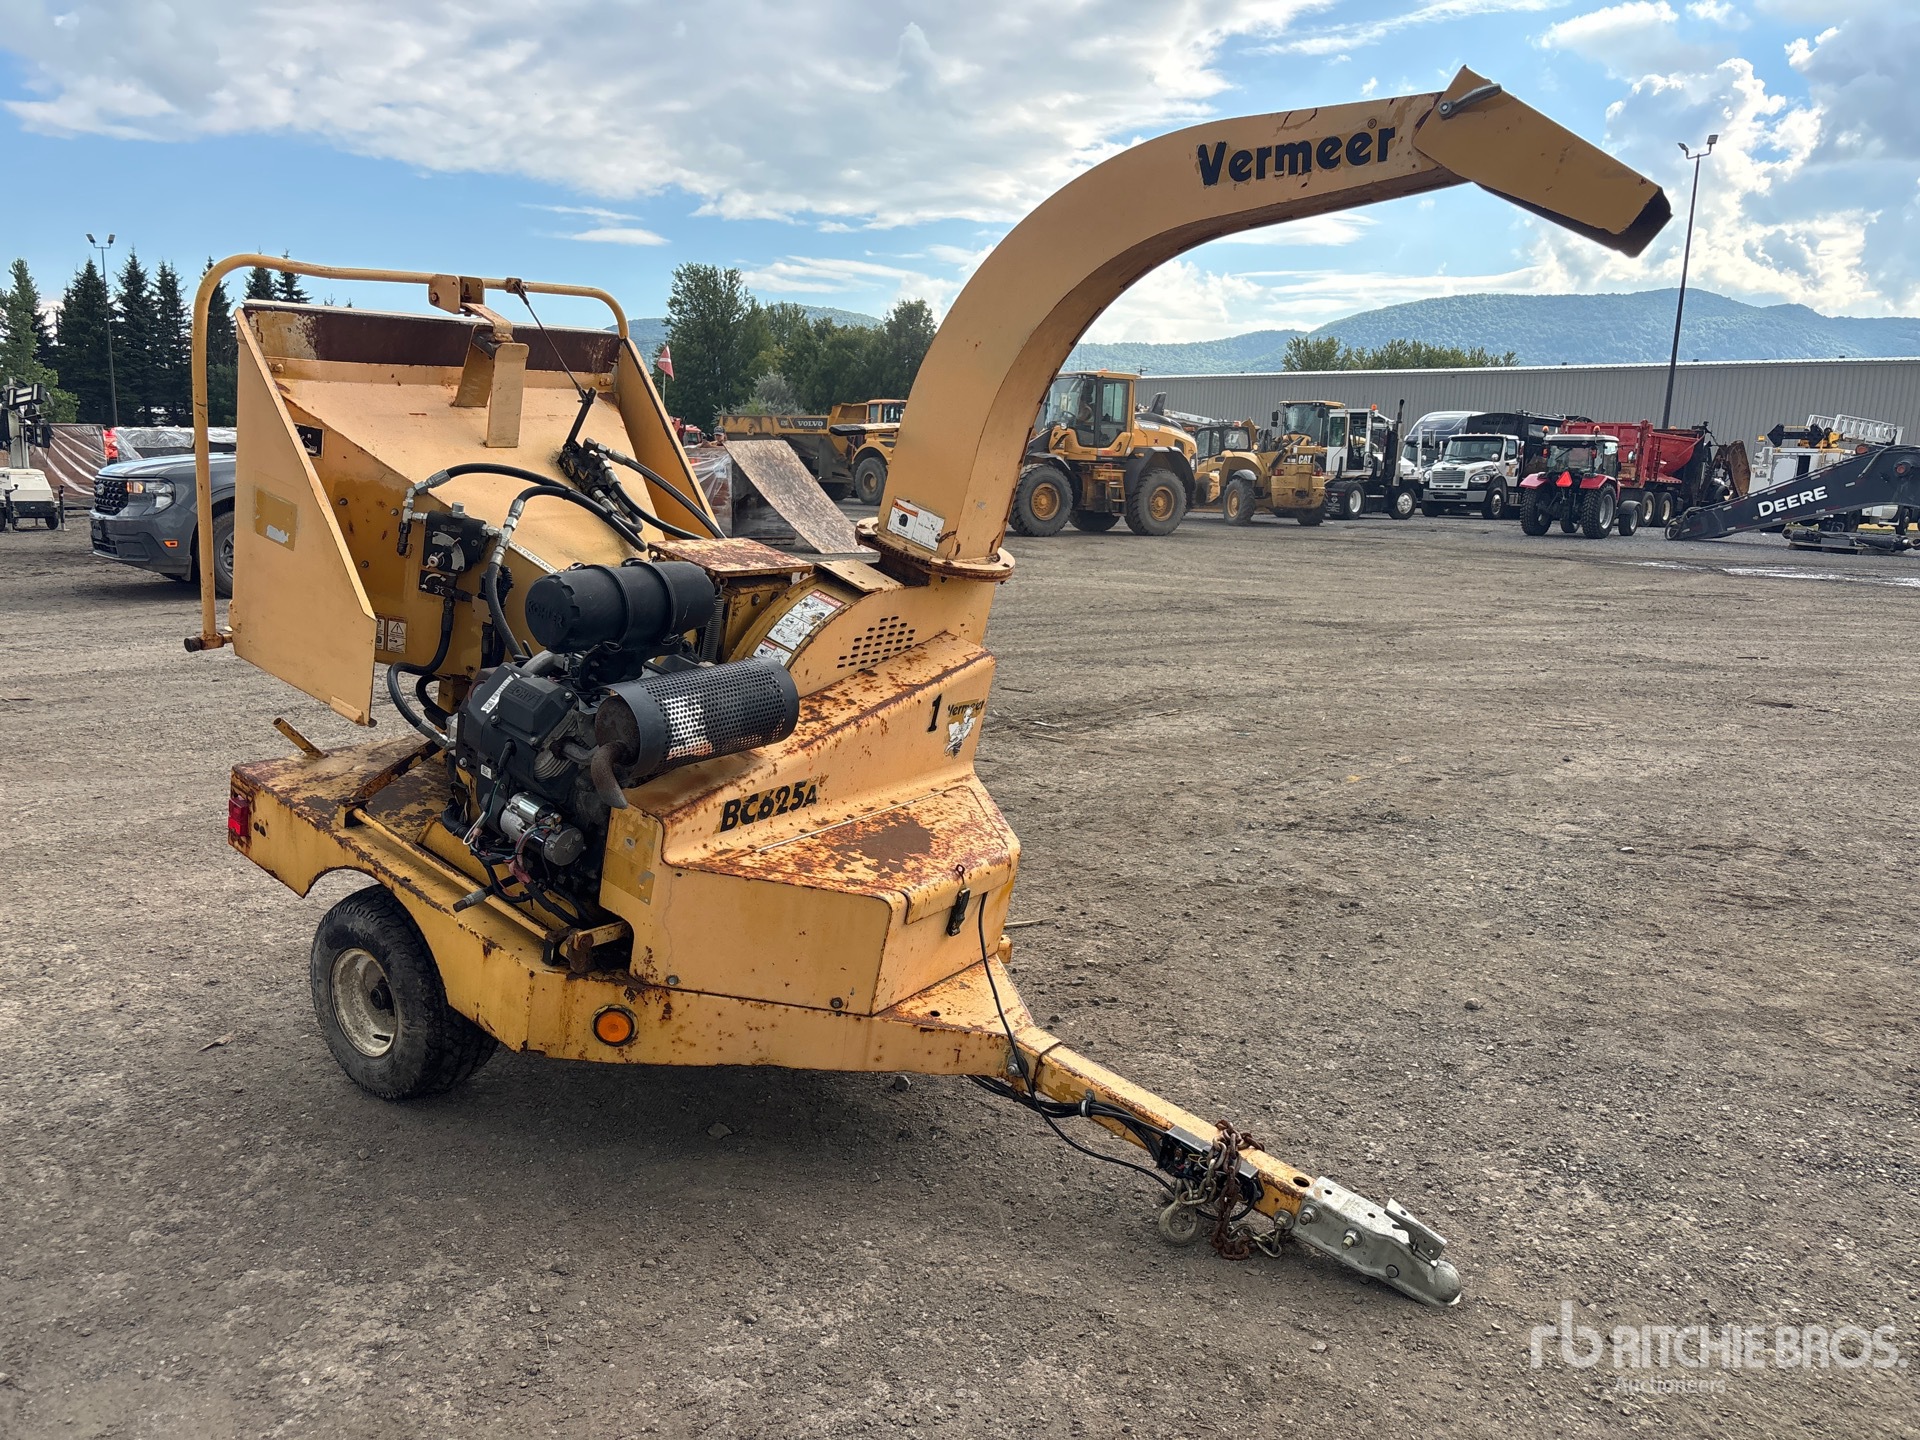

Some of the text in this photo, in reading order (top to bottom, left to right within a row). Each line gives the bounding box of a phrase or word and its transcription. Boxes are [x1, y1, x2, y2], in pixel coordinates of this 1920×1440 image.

[1197, 126, 1396, 186] Vermeer
[1298, 454, 1313, 465] CAT
[1757, 485, 1828, 517] DEERE
[926, 693, 943, 733] 1
[720, 780, 818, 833] BC625A
